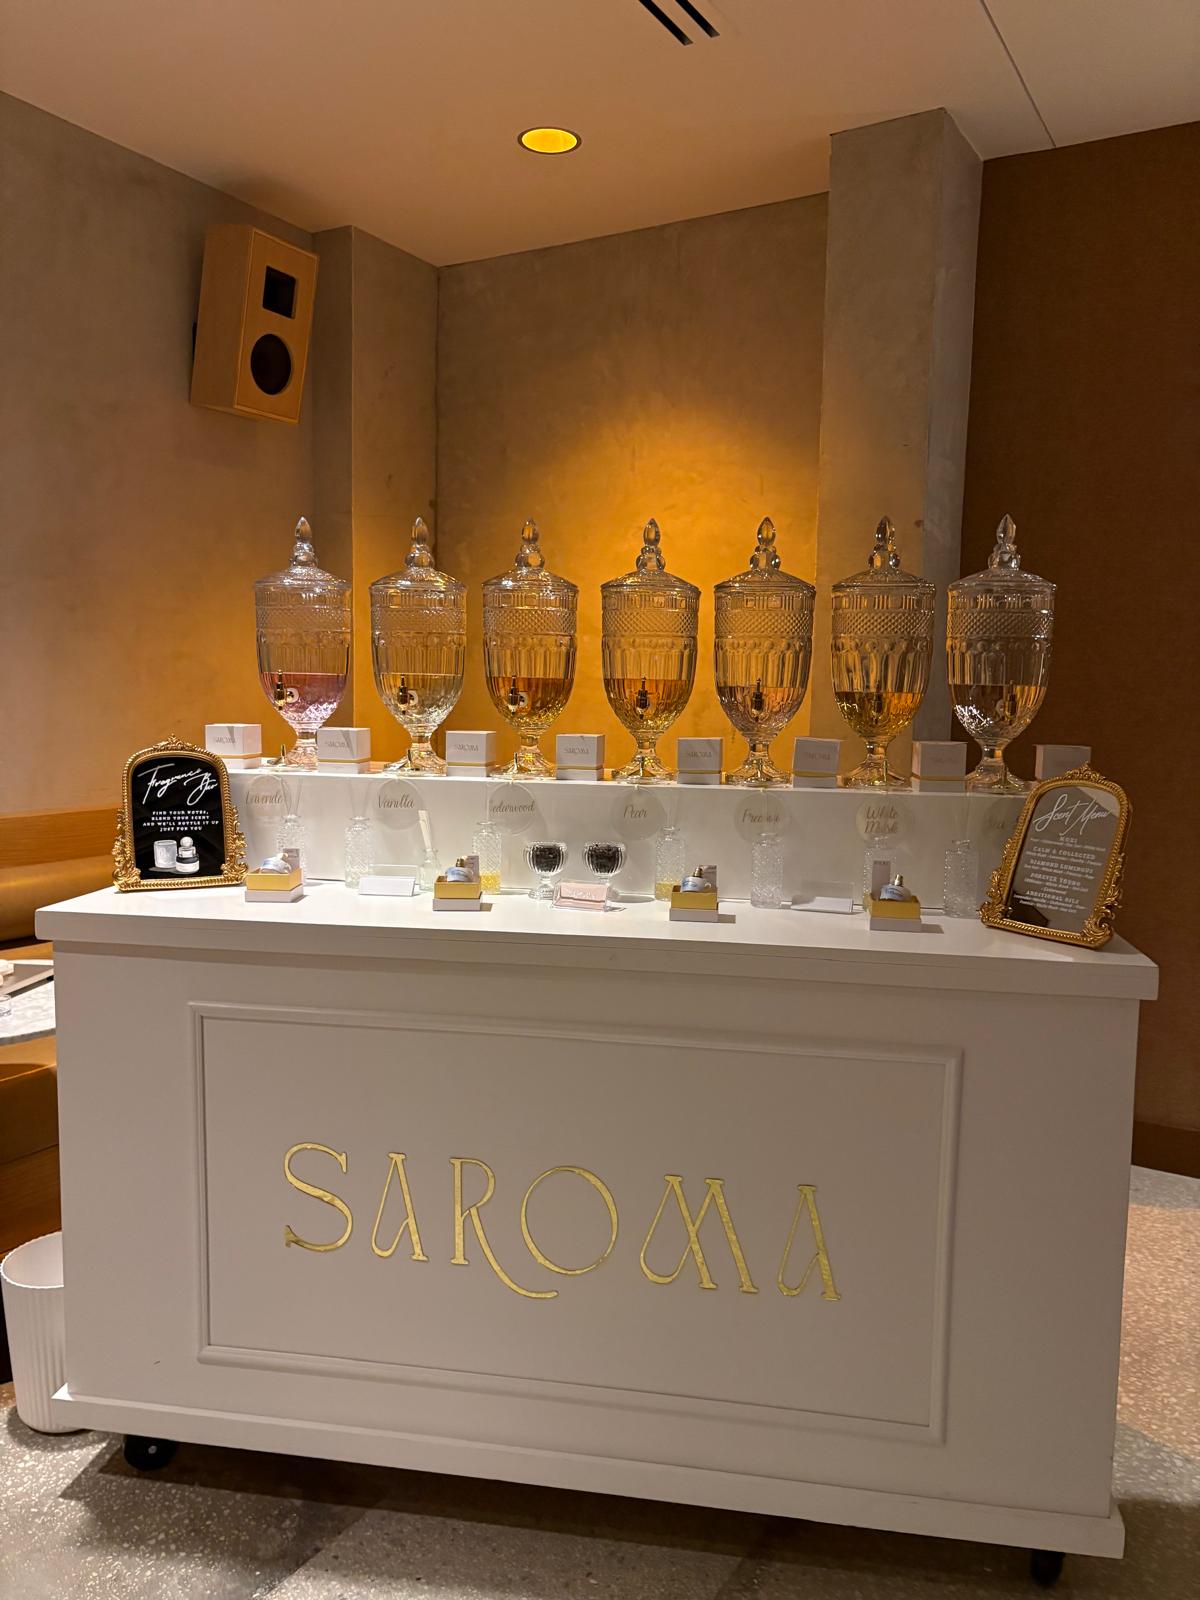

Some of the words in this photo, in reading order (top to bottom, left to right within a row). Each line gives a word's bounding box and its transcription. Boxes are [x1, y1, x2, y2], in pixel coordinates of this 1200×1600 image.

[137, 763, 202, 804] Fragrance
[245, 790, 285, 805] Lavende
[378, 793, 415, 809] Vanilla
[489, 800, 536, 813] edarwood
[623, 804, 648, 819] Pear
[1033, 793, 1090, 832] Scent
[1059, 799, 1112, 836] Menu
[284, 1142, 841, 1301] SAROMA
